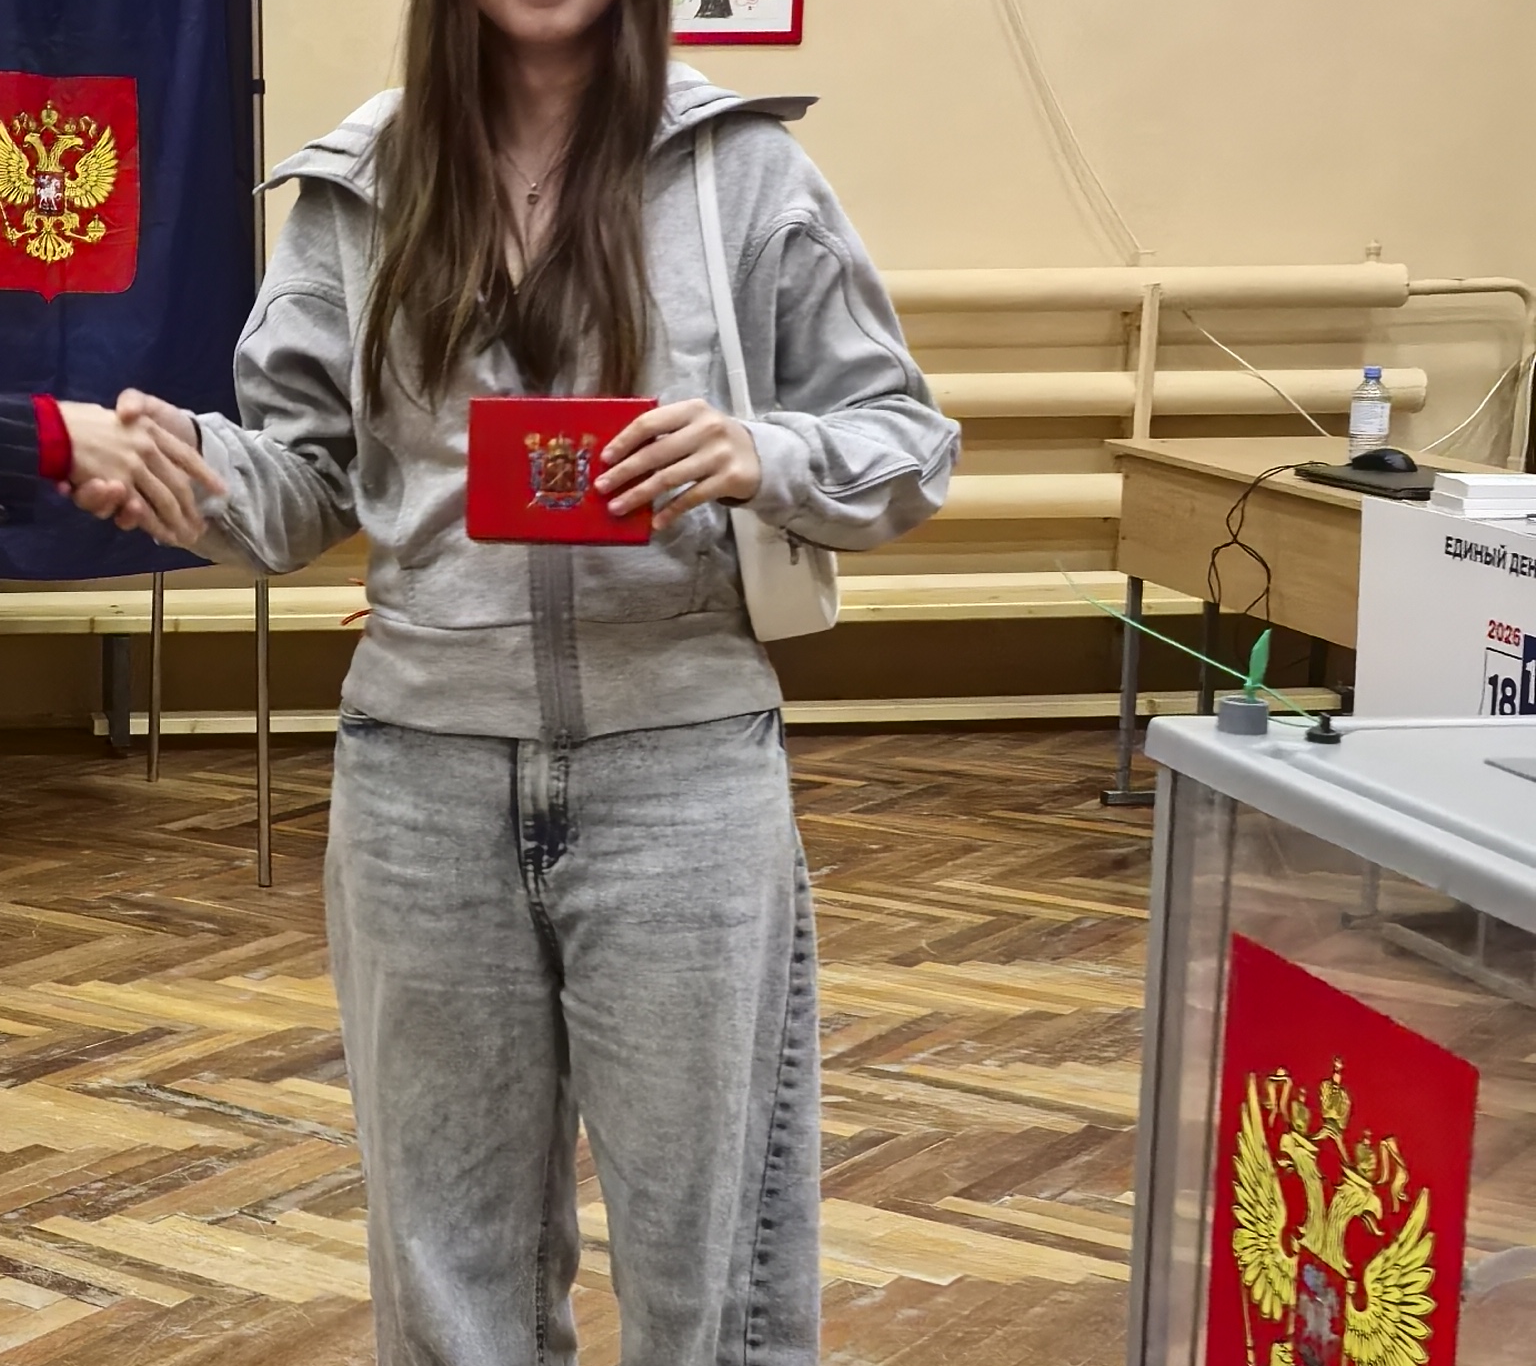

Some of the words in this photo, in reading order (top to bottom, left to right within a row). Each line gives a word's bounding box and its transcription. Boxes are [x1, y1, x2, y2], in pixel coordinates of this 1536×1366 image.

[1444, 536, 1507, 570] ЕДИНЫЙ
[1509, 552, 1536, 579] ДЕН
[1487, 619, 1522, 647] 2026
[1488, 673, 1517, 716] 18
[1525, 659, 1536, 705] 1
